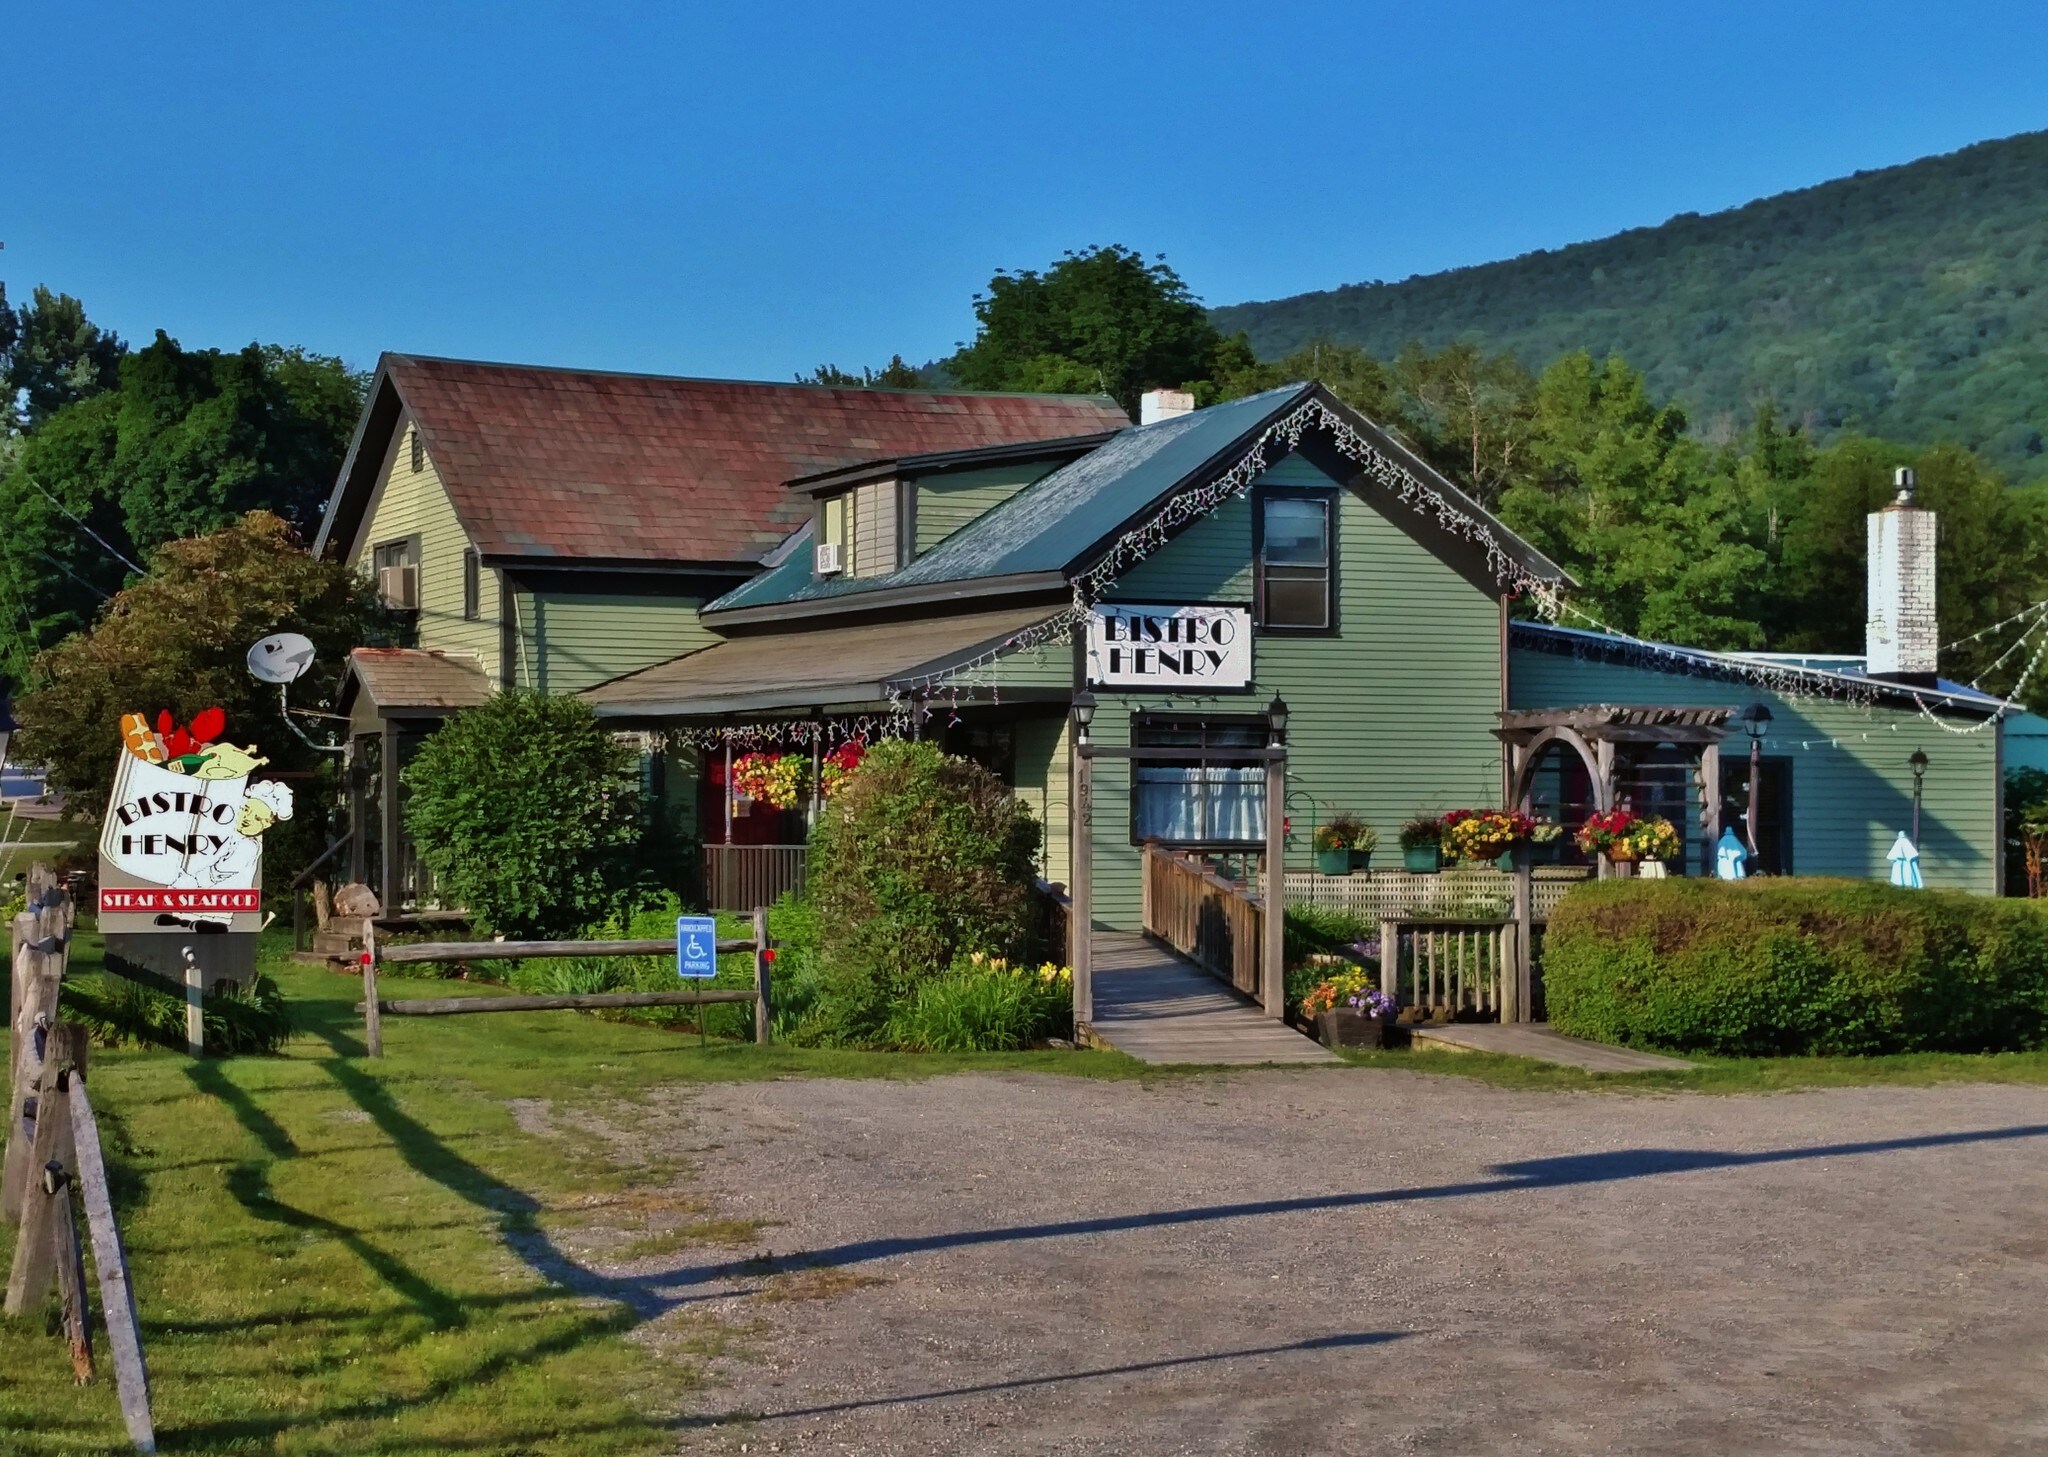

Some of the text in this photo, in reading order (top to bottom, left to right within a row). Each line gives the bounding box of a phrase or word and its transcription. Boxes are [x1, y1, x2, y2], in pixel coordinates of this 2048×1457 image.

[1104, 615, 1235, 646] BISTRO
[1109, 648, 1230, 676] HENRY
[116, 791, 235, 827] BISTRO
[121, 833, 230, 855] HENRY
[103, 894, 257, 907] STEAK & SEAFOOD
